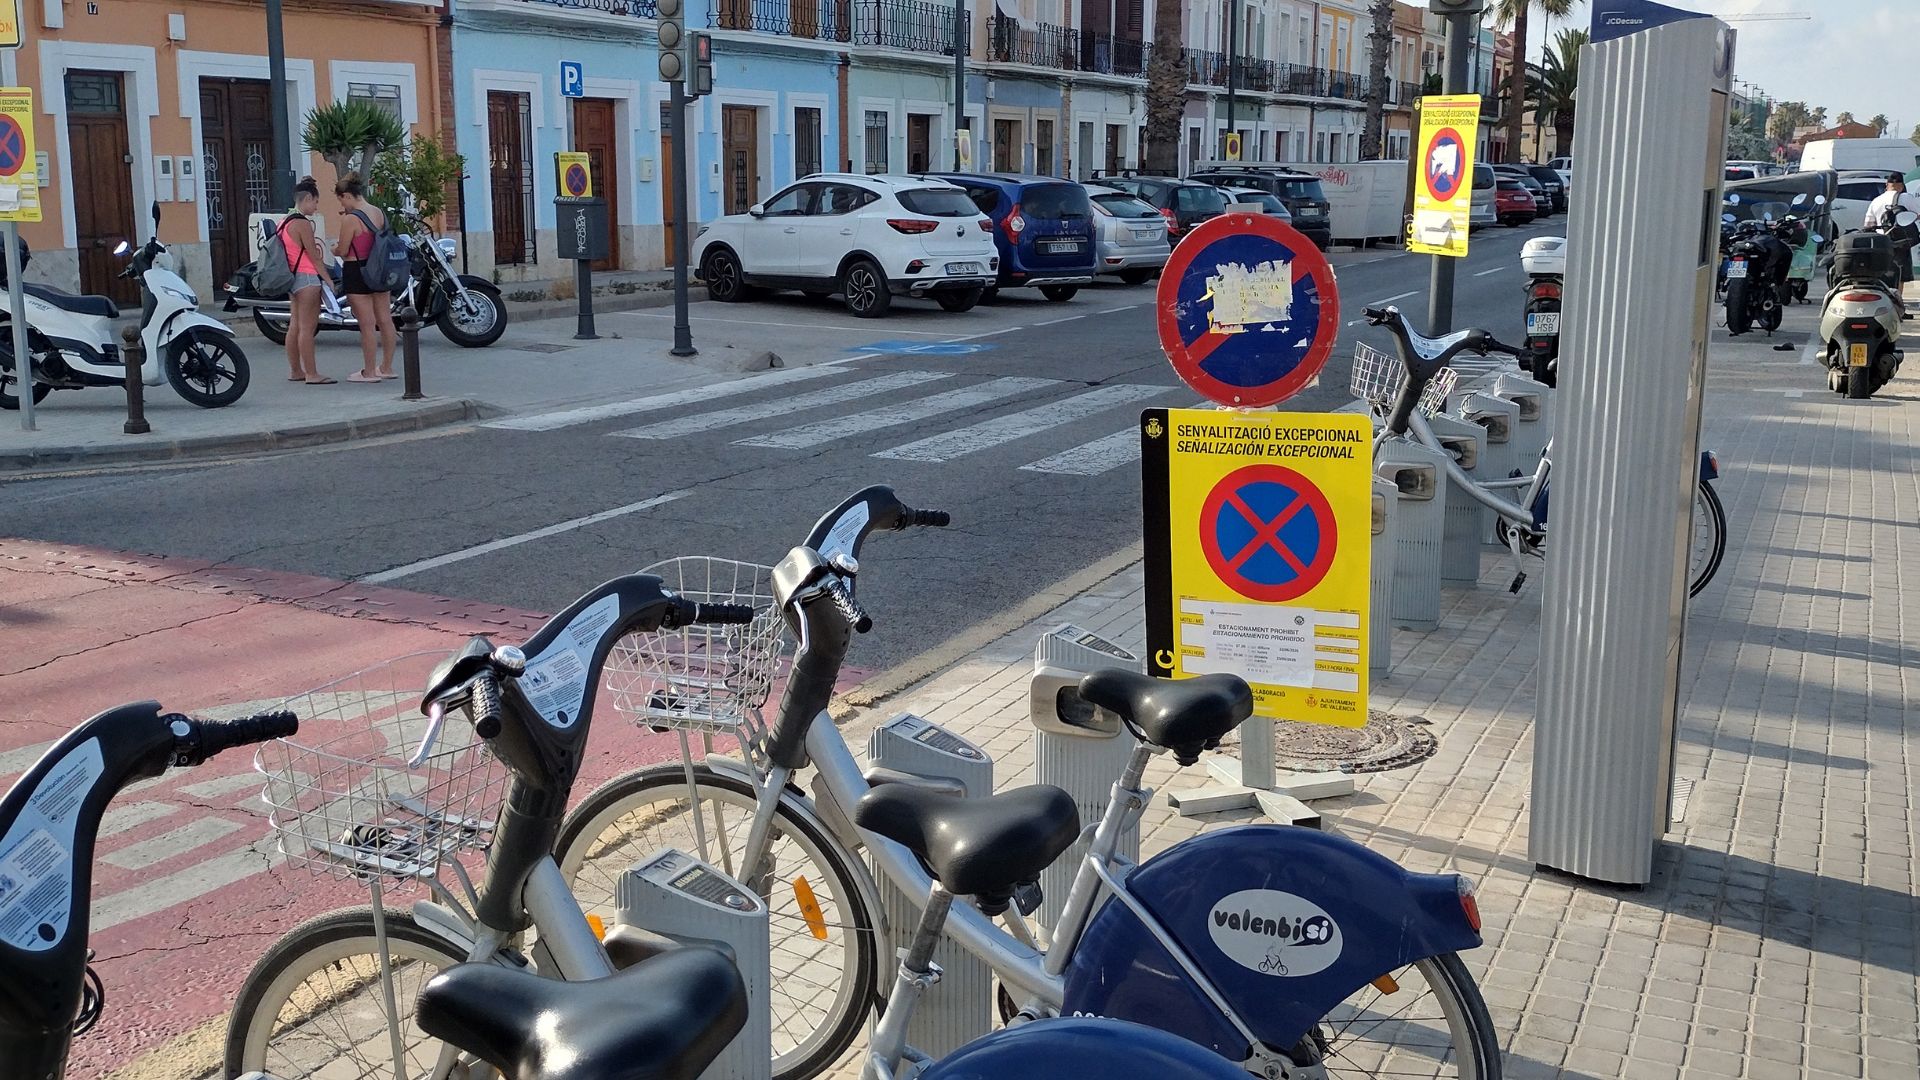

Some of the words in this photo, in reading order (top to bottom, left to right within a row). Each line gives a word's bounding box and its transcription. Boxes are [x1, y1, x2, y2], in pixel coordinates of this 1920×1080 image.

[564, 65, 578, 92] P
[1535, 315, 1557, 323] 0767
[1177, 424, 1271, 440] SENYALITZACIÓ
[1275, 427, 1363, 442] EXCEPCIONAL
[1176, 438, 1264, 456] SEÑALIZACIÓN
[1267, 444, 1355, 459] EXCEPCIONAL
[1218, 624, 1269, 633] ESTACIONAMENT
[1212, 630, 1270, 640] ESTACIONAMIENTO
[1271, 634, 1305, 642] PROHIBIDO
[1320, 698, 1356, 707] AJUNTAMENT
[653, 859, 677, 872] 10
[1214, 909, 1328, 941] valenbisi
